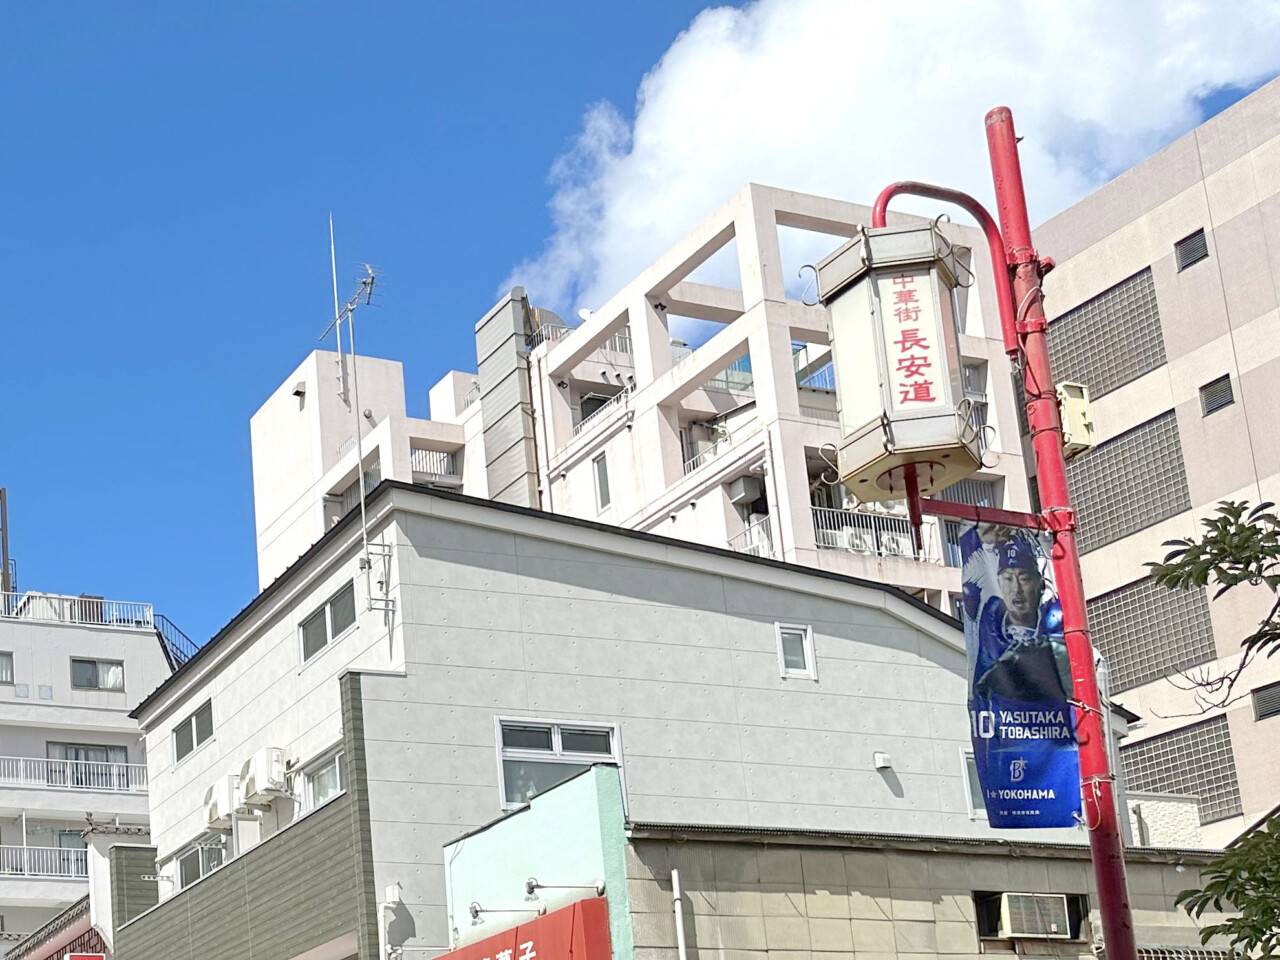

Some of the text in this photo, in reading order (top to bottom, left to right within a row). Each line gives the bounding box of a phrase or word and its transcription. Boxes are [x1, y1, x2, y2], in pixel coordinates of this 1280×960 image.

[892, 273, 922, 324] 中華街
[893, 328, 936, 404] 長安道
[970, 710, 1065, 739] 10 YASUTAKA
[998, 726, 1071, 740] TOBASHIRA
[998, 789, 1055, 800] YOKOHAMA
